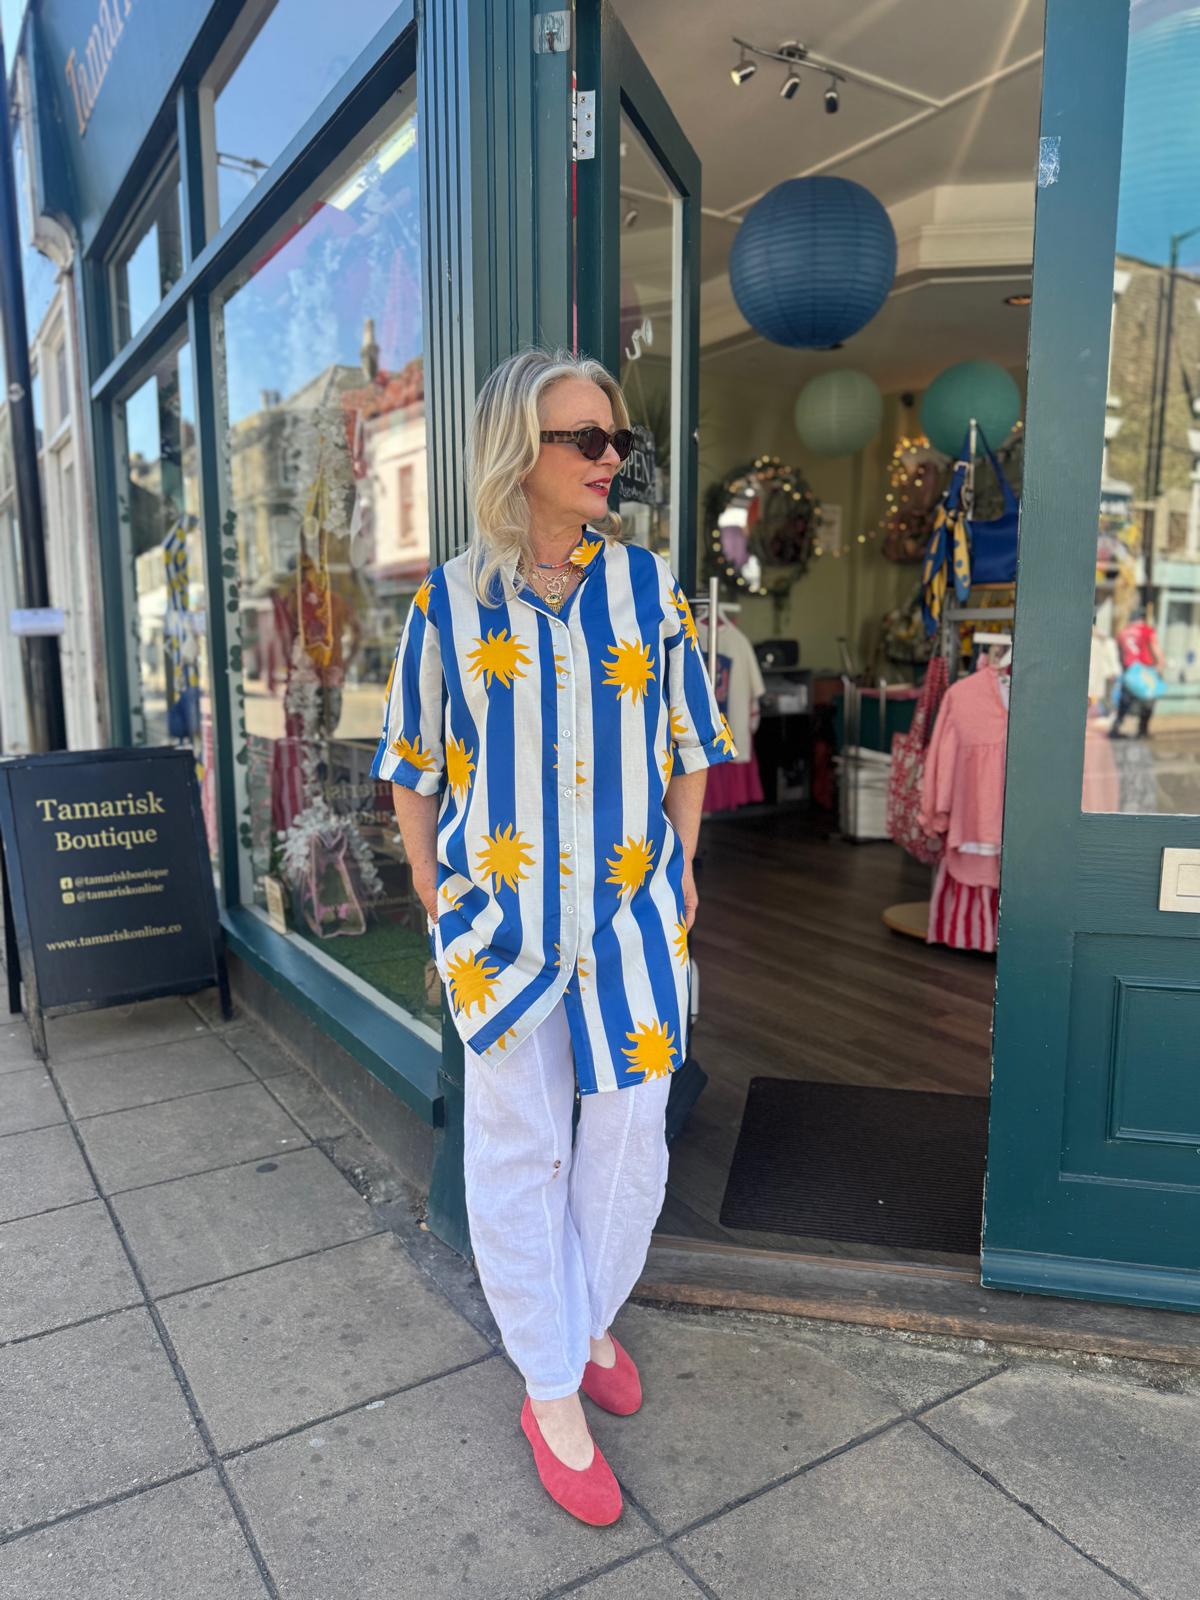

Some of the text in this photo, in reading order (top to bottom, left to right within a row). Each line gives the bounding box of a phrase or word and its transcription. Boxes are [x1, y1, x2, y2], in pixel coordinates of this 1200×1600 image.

[36, 791, 165, 821] Tamarisk
[55, 827, 158, 851] Boutique
[75, 868, 169, 888] @tamariskboutique
[77, 882, 165, 903] @tamariskonline
[46, 923, 182, 951] www.tamariskonline.co
